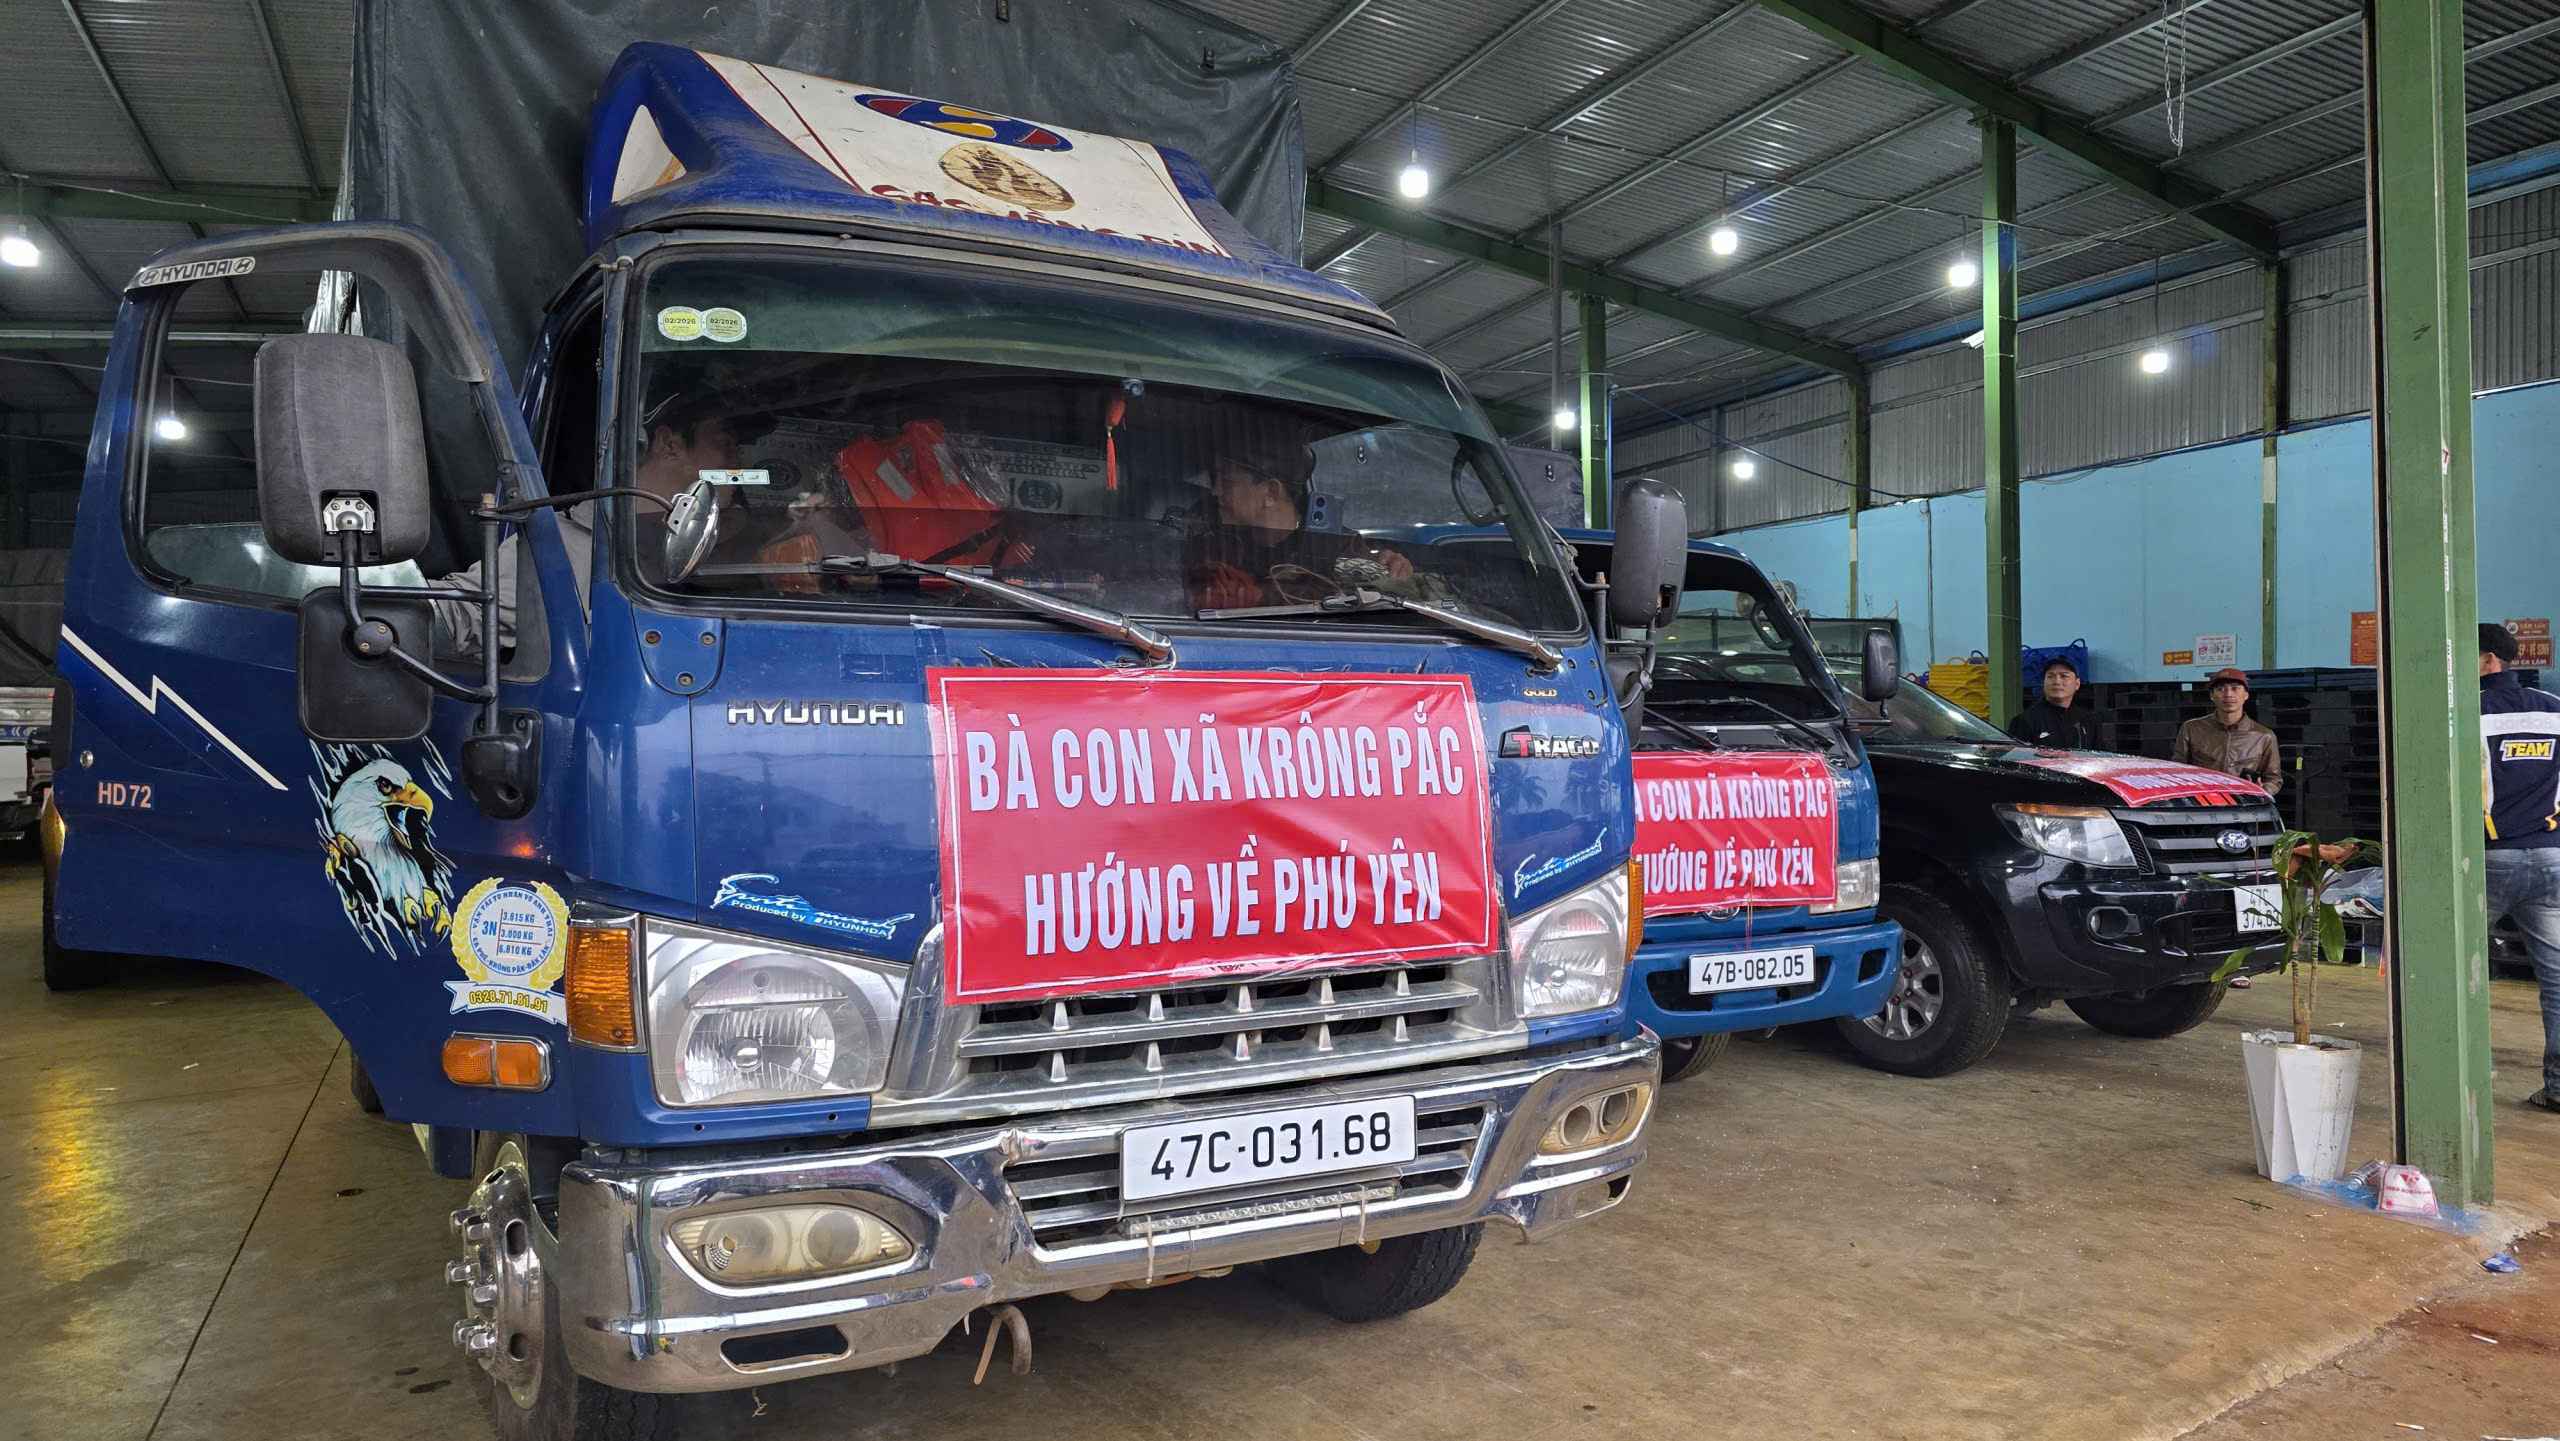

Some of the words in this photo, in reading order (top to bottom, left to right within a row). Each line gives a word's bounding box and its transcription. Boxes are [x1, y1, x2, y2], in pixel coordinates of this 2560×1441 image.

[161, 260, 232, 282] HYUNDAI
[1523, 688, 1558, 697] GOLD
[728, 699, 904, 725] HYUNDAI
[965, 713, 1039, 812] BÀ
[1052, 727, 1155, 808] CON
[1163, 712, 1233, 803] XÃ
[1240, 710, 1383, 800] KRÔNG
[1387, 701, 1464, 796] PẮC
[1511, 733, 1600, 759] TRAGO
[2504, 743, 2552, 758] TEAM
[1647, 779, 1693, 822] CON
[1698, 772, 1725, 820] XÃ
[1726, 771, 1791, 820] KRÔNG
[1714, 837, 1735, 890] VỀ
[1782, 839, 1815, 886] YÊN
[1024, 851, 1195, 956] HƯỚNG
[1206, 834, 1261, 938] VỀ
[1274, 839, 1358, 933] PHÚ
[1370, 838, 1441, 925] YÊN
[2250, 889, 2269, 907] 47C
[503, 911, 524, 923] 3.615
[525, 912, 536, 923] KG
[731, 899, 794, 918] Produced
[792, 911, 807, 923] by
[481, 921, 498, 936] 3N
[501, 929, 522, 940] 3.000
[523, 930, 534, 941] KG
[499, 944, 520, 955] 6.810
[521, 945, 532, 956] KG
[1702, 954, 1804, 985] 47B-082.05
[469, 990, 548, 1013] 0328.71.81.91
[1151, 1111, 1392, 1181] 47C-031.68
